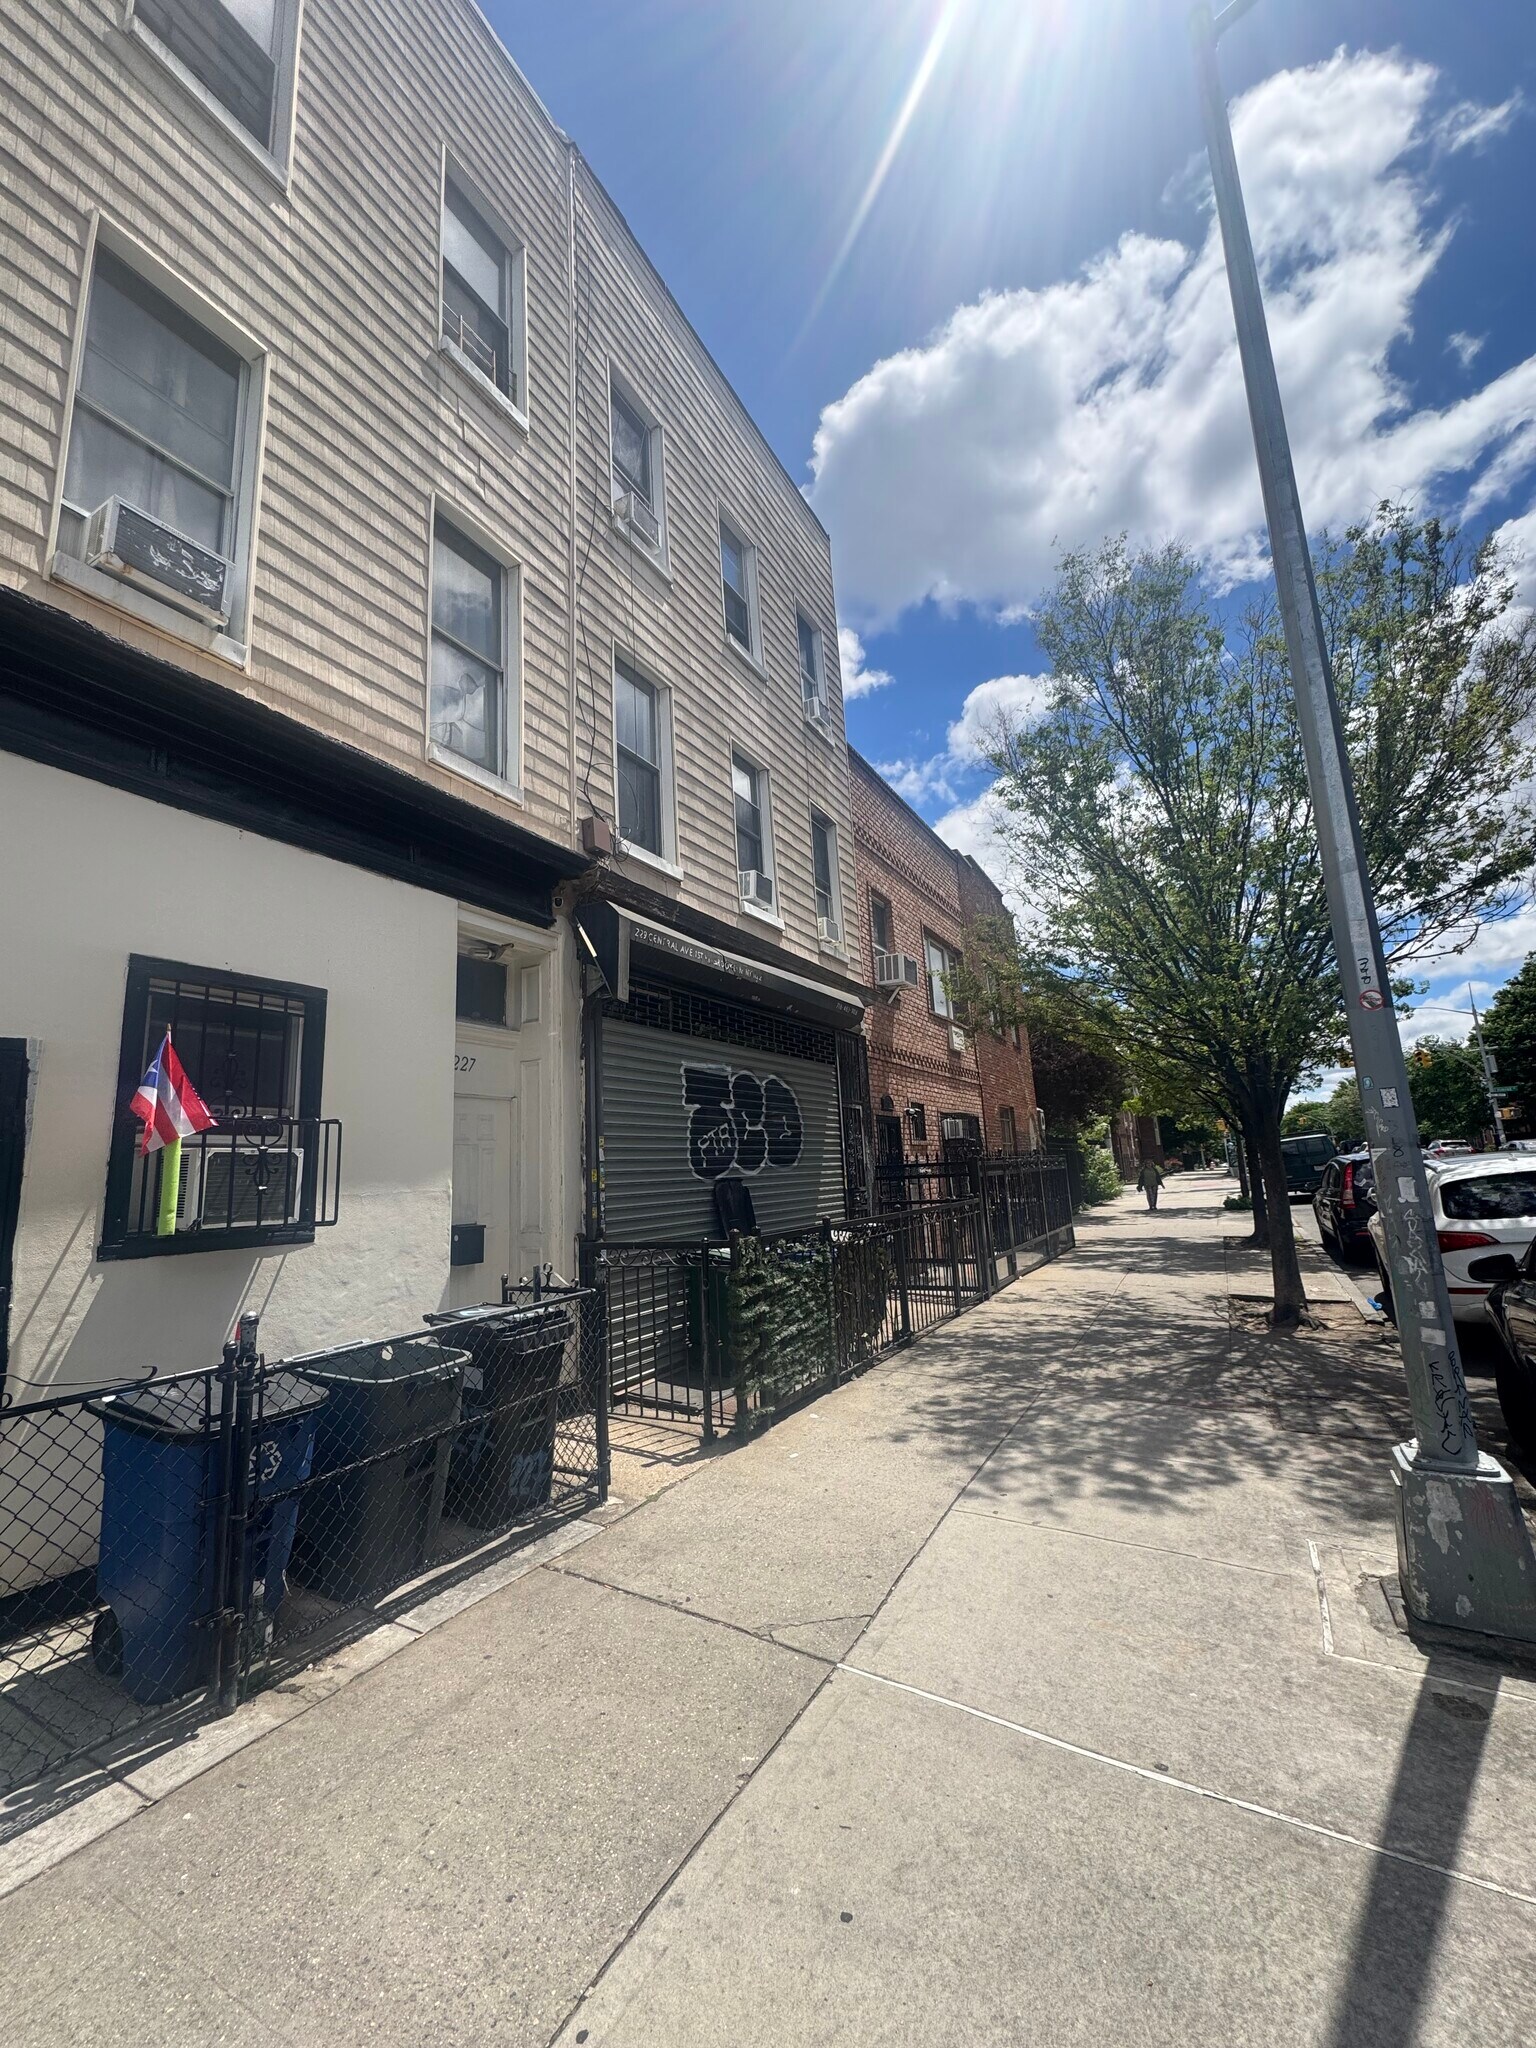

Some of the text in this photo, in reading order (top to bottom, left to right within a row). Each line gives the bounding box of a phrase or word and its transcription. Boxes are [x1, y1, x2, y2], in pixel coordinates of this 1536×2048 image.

[634, 927, 648, 940] 229
[648, 932, 679, 952] CENTRAL
[454, 1055, 476, 1073] 227
